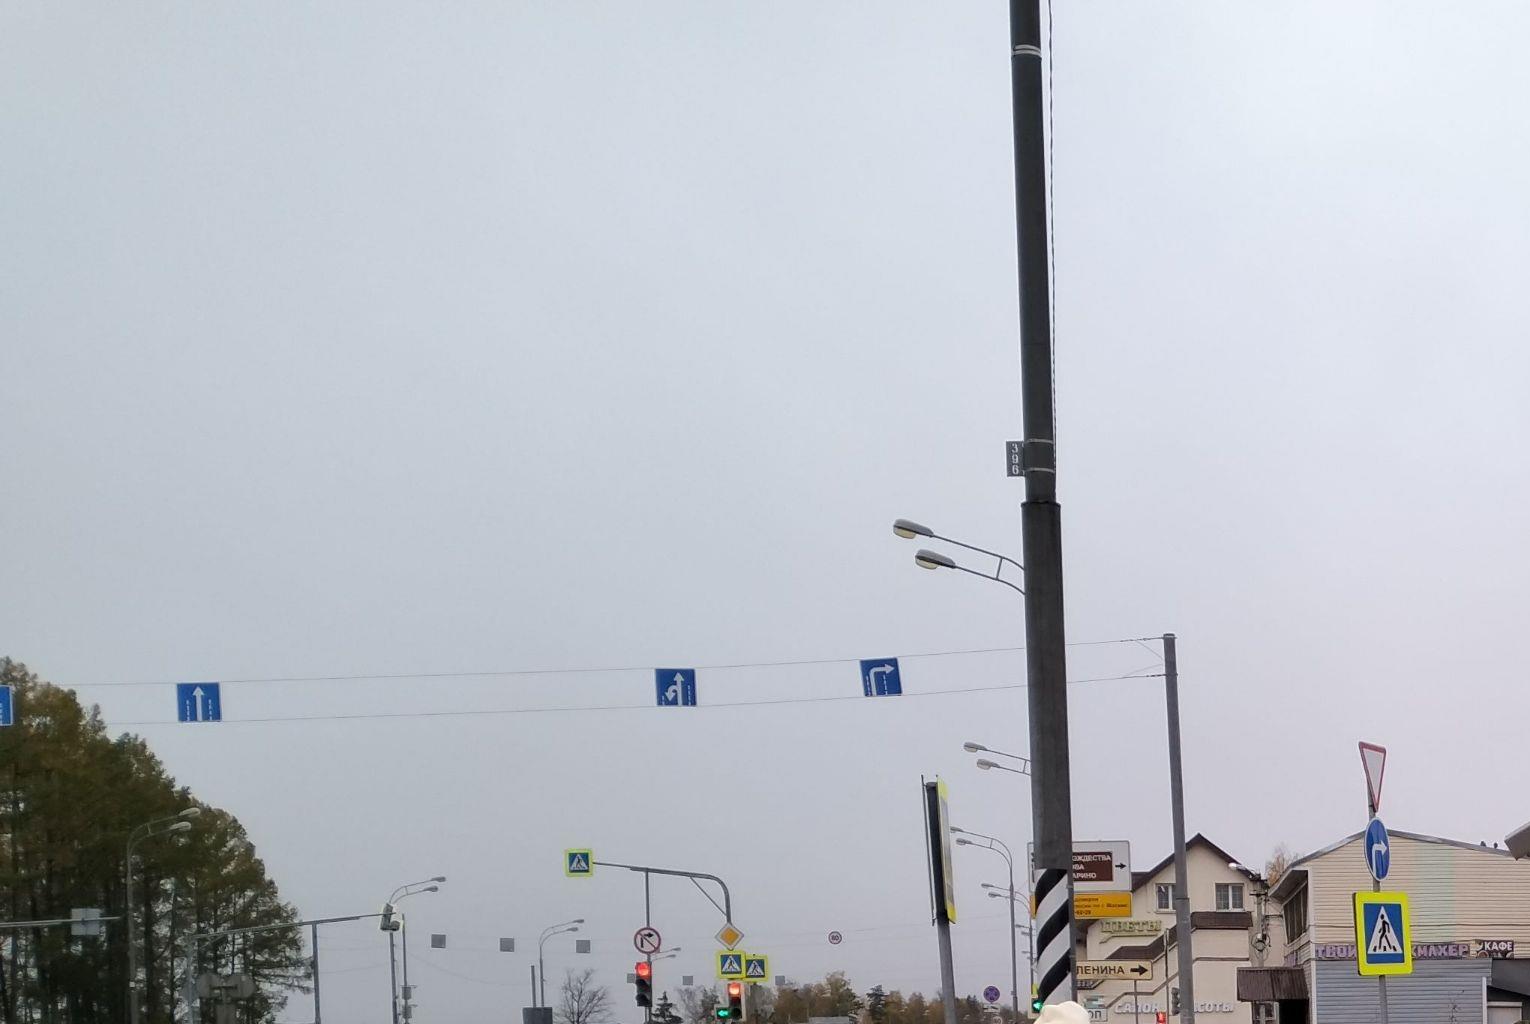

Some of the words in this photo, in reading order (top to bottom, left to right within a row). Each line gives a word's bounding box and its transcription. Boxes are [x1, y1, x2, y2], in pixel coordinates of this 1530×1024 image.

[1011, 443, 1019, 475] 396
[1072, 854, 1112, 862] ОЖДЕСТВА
[1484, 941, 1513, 951] КАФЕ
[1076, 965, 1125, 975] ЛЕНИНА
